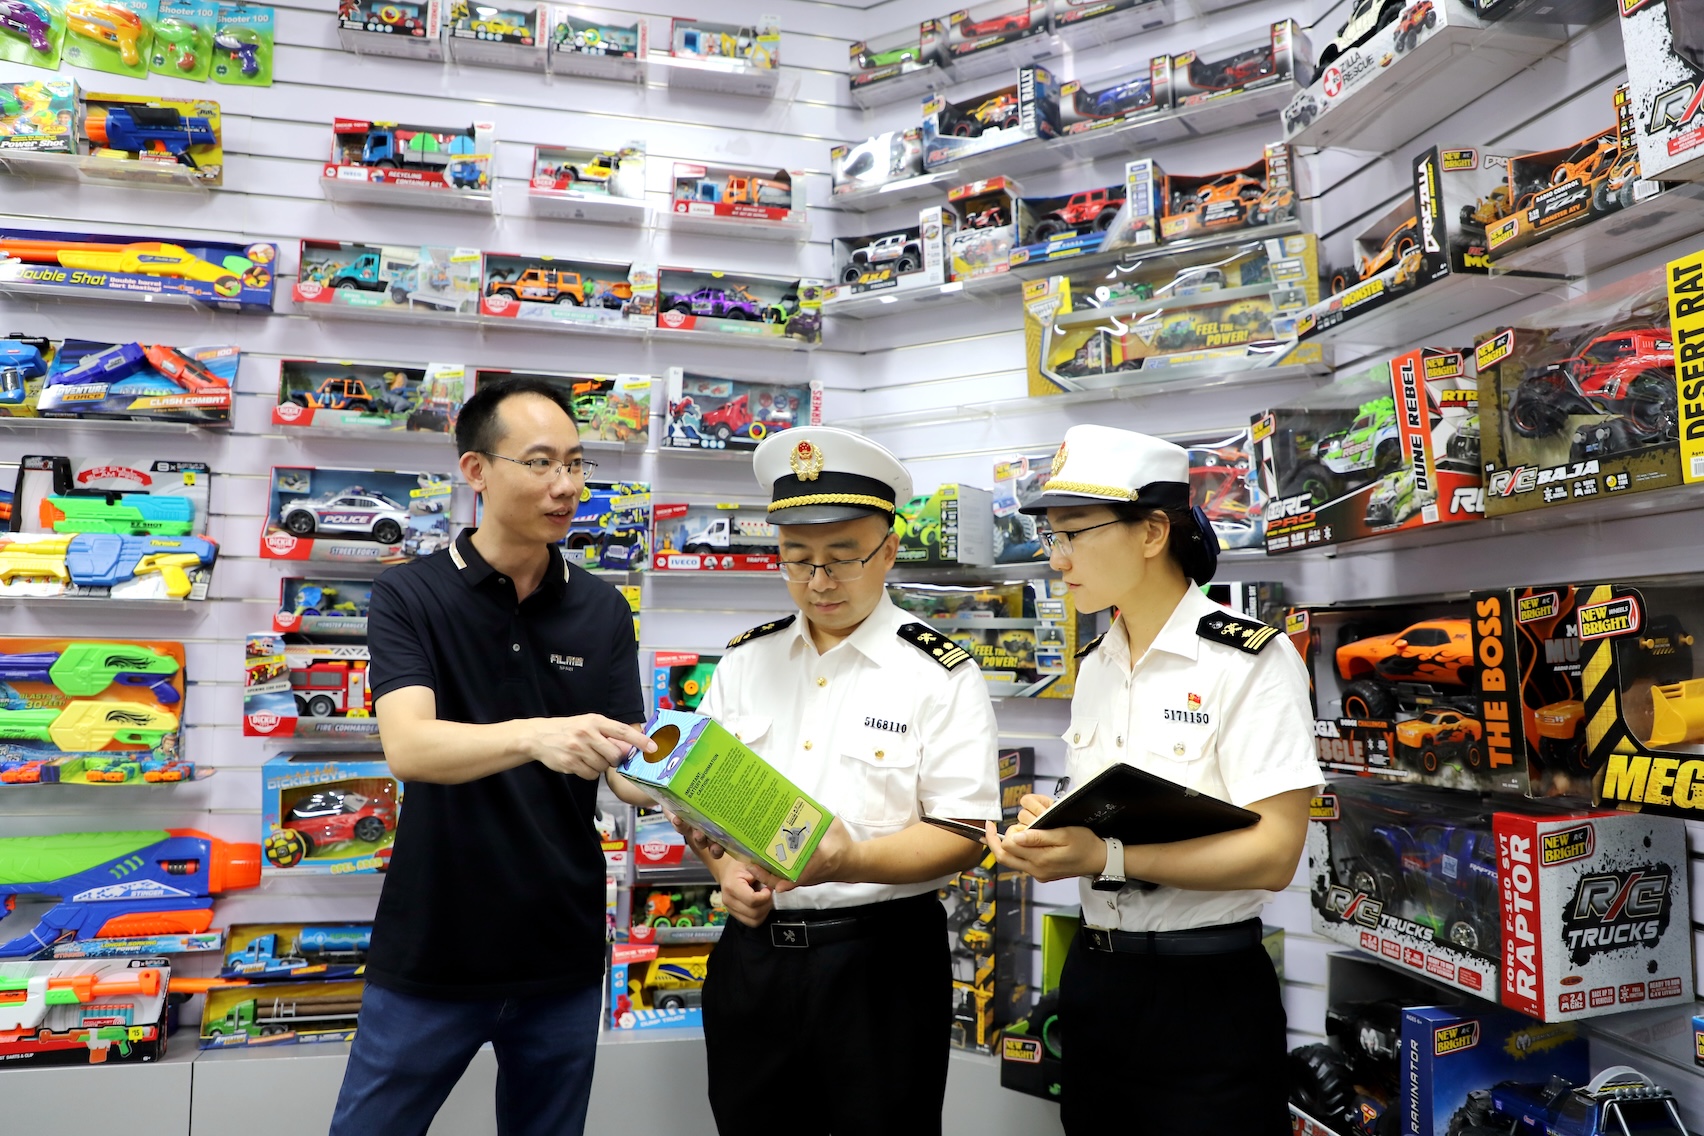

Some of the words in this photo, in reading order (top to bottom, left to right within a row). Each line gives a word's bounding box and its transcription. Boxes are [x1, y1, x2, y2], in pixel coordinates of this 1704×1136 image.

[130, 1, 147, 10] 300
[160, 5, 194, 16] Shooter
[196, 8, 213, 17] 100
[217, 14, 251, 24] Shooter
[253, 15, 269, 23] 100
[1340, 52, 1362, 73] ZILLA
[1342, 54, 1375, 85] RESCUE
[1020, 70, 1035, 102] RALLY
[1022, 102, 1036, 130] BAJA
[1, 140, 38, 150] Power
[40, 140, 64, 148] Shot
[1444, 152, 1461, 161] NEW
[1444, 160, 1473, 169] BRIGHT
[388, 170, 422, 179] RECYCLING
[396, 178, 431, 187] CONTAINER
[1536, 189, 1553, 204] RADIO
[1554, 180, 1580, 195] CONTROL
[1544, 188, 1589, 216] RZR
[1539, 209, 1569, 226] MONSTER
[1568, 204, 1581, 215] ATV
[1490, 227, 1505, 241] NEW
[1491, 231, 1515, 248] BRIGHT
[14, 268, 66, 283] Double
[72, 272, 107, 287] Shot
[110, 277, 139, 286] Double
[140, 279, 162, 287] barrel
[109, 282, 127, 290] dart
[128, 284, 162, 293] blasting!
[1341, 280, 1385, 307] MONSTER
[1674, 263, 1704, 319] RAT
[1196, 322, 1219, 336] FEEL
[1206, 330, 1249, 347] POWER!
[216, 348, 233, 356] 100
[1478, 342, 1496, 358] NEW
[1478, 346, 1508, 369] BRIGHT
[1426, 358, 1445, 370] NEW
[1426, 364, 1458, 377] BRIGHT
[1401, 358, 1422, 428] REBEL
[1678, 330, 1704, 441] DESERT
[150, 398, 183, 406] CLASH
[184, 396, 227, 405] COMBAT
[1342, 441, 1372, 458] REBEL
[91, 467, 105, 475] EZ
[110, 466, 131, 476] PULL
[1411, 435, 1429, 492] DUNE
[86, 471, 116, 483] SLAM
[1488, 466, 1539, 498] R/C
[1537, 460, 1601, 485] BAJA
[1280, 492, 1313, 518] RC
[324, 514, 370, 524] POLICE
[1268, 512, 1317, 531] PRO
[268, 538, 295, 548] DICKIE
[330, 546, 354, 557] STREET
[355, 547, 380, 557] FORCE
[1520, 598, 1540, 611] NEW
[277, 614, 295, 623] DICKIE
[1520, 605, 1554, 622] BRIGHT
[1580, 606, 1608, 622] NEW
[1608, 605, 1629, 616] WHEELS
[1582, 616, 1630, 636] BRIGHT
[974, 646, 994, 656] FEEL
[1476, 596, 1507, 693] BOSS
[982, 656, 1019, 668] POWER!
[25, 701, 42, 709] 30
[250, 716, 278, 727] DICKIE
[1164, 709, 1209, 725] 5171150
[316, 723, 333, 732] FIRE
[864, 716, 907, 734] 5168110
[1484, 700, 1514, 769] THE
[699, 754, 720, 781] INFORMATION
[268, 774, 313, 790] DICKIE
[314, 770, 347, 785] TOYS
[687, 779, 703, 799] BATTERY
[643, 844, 667, 853] DICKIE
[1544, 833, 1569, 850] NEW
[1499, 833, 1511, 871] SVT
[1544, 842, 1586, 863] BRIGHT
[1470, 863, 1499, 879] RAPTO
[130, 889, 165, 898] STINGER
[1574, 871, 1669, 923] R/C
[1504, 878, 1515, 932] F-150
[1326, 884, 1384, 929] R/C
[1379, 913, 1435, 942] TRUCKS
[1509, 834, 1537, 1001] RAPTOR
[330, 932, 363, 941] SPRING
[1568, 920, 1660, 950] TRUCKS
[128, 940, 158, 948] SOAKING
[616, 950, 638, 958] DICKIE
[1506, 939, 1515, 994] FORD
[1649, 981, 1662, 989] READY
[1662, 980, 1669, 988] TO
[1670, 979, 1681, 987] RUN
[1570, 994, 1583, 1002] 2.4
[1590, 990, 1601, 998] RACE
[1596, 995, 1614, 1006] VEHICLES
[1570, 1000, 1584, 1009] GHz
[640, 1020, 660, 1028] DUMP
[662, 1015, 686, 1025] TRUCK
[1406, 1014, 1417, 1024] AGES
[1437, 1028, 1459, 1042] NEW
[1005, 1040, 1022, 1050] NEW
[1437, 1036, 1473, 1053] BRIGHT
[1006, 1048, 1036, 1060] BRIGHT
[1410, 1038, 1419, 1135] RAMINATOR
